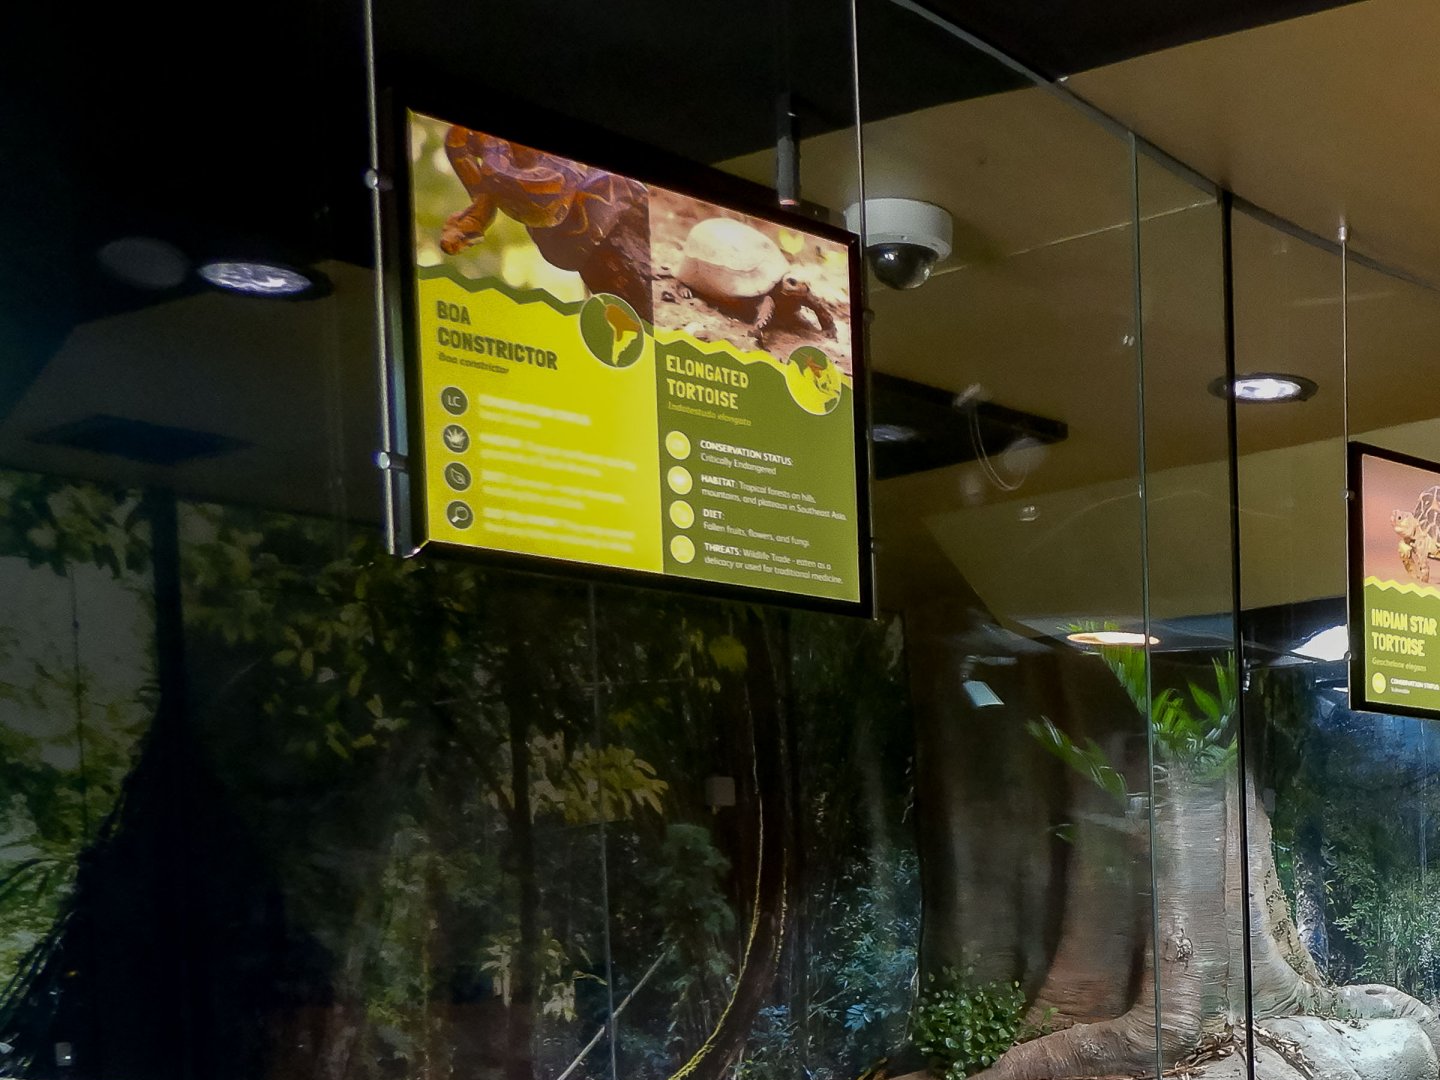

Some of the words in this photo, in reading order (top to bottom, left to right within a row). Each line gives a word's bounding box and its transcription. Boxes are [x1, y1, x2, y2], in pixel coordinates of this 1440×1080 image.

[436, 300, 471, 325] BOA
[437, 326, 558, 370] CONSTRICTOR
[666, 354, 750, 388] ELONGATED
[447, 395, 461, 407] LC
[666, 378, 739, 410] TORTOISE
[700, 440, 762, 460] CONSERVATION
[700, 452, 733, 469] Critically
[733, 459, 777, 475] Endangered
[703, 508, 725, 520] DIET:
[703, 520, 726, 532] Fallen
[704, 542, 742, 556] THREATS:
[1371, 608, 1409, 631] INDIAN
[1409, 615, 1438, 637] STAR
[1371, 631, 1426, 657] TORTOISE
